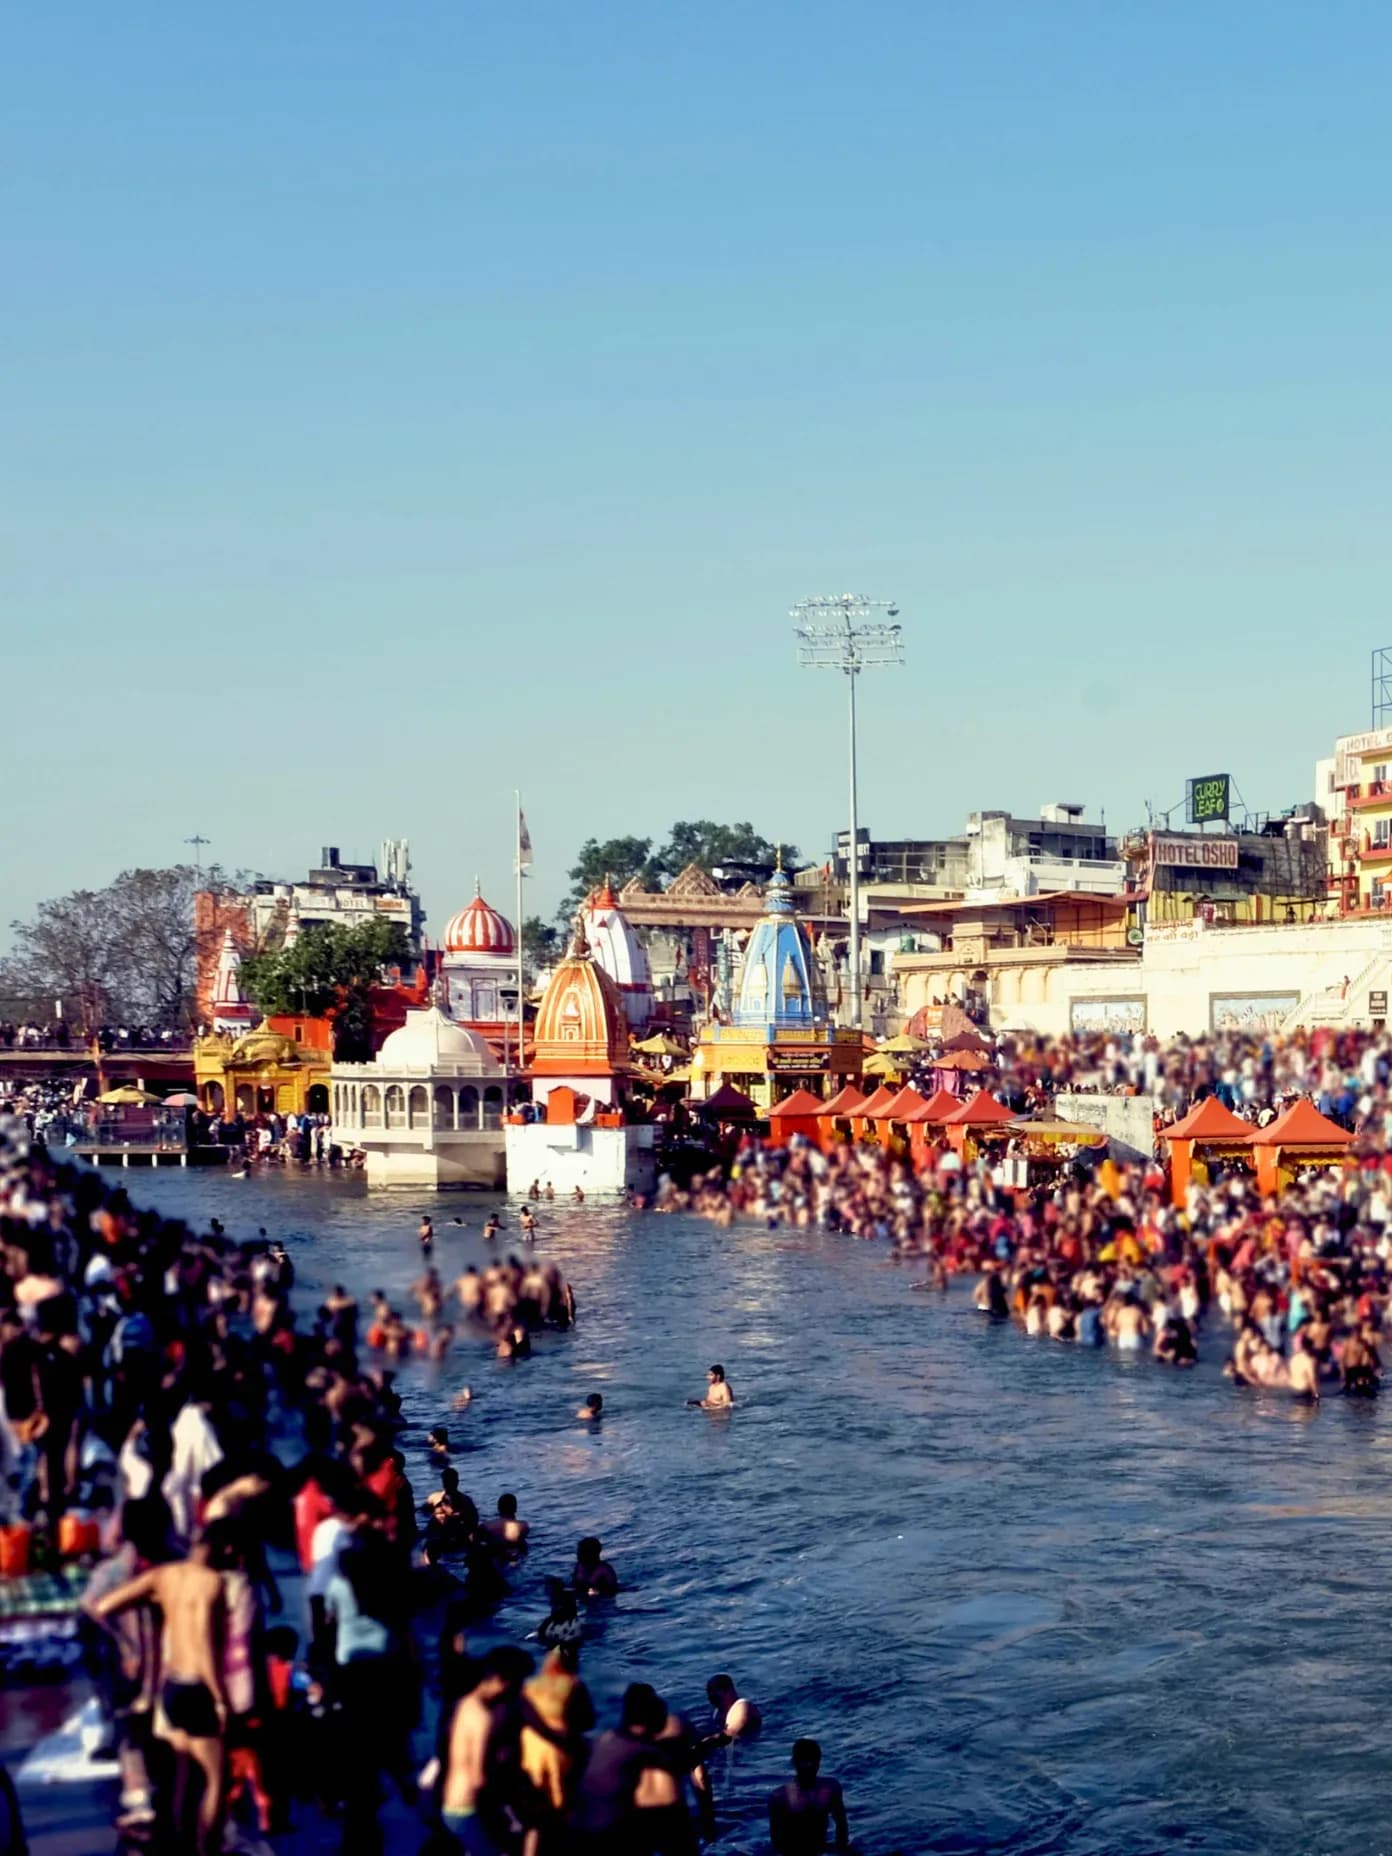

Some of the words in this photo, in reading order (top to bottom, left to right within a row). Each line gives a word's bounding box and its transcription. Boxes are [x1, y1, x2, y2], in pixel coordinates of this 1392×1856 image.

[1195, 779, 1226, 800] CURRY
[1195, 798, 1216, 818] LEAF
[1158, 843, 1201, 864] HOTEL
[1202, 843, 1237, 866] OSHO
